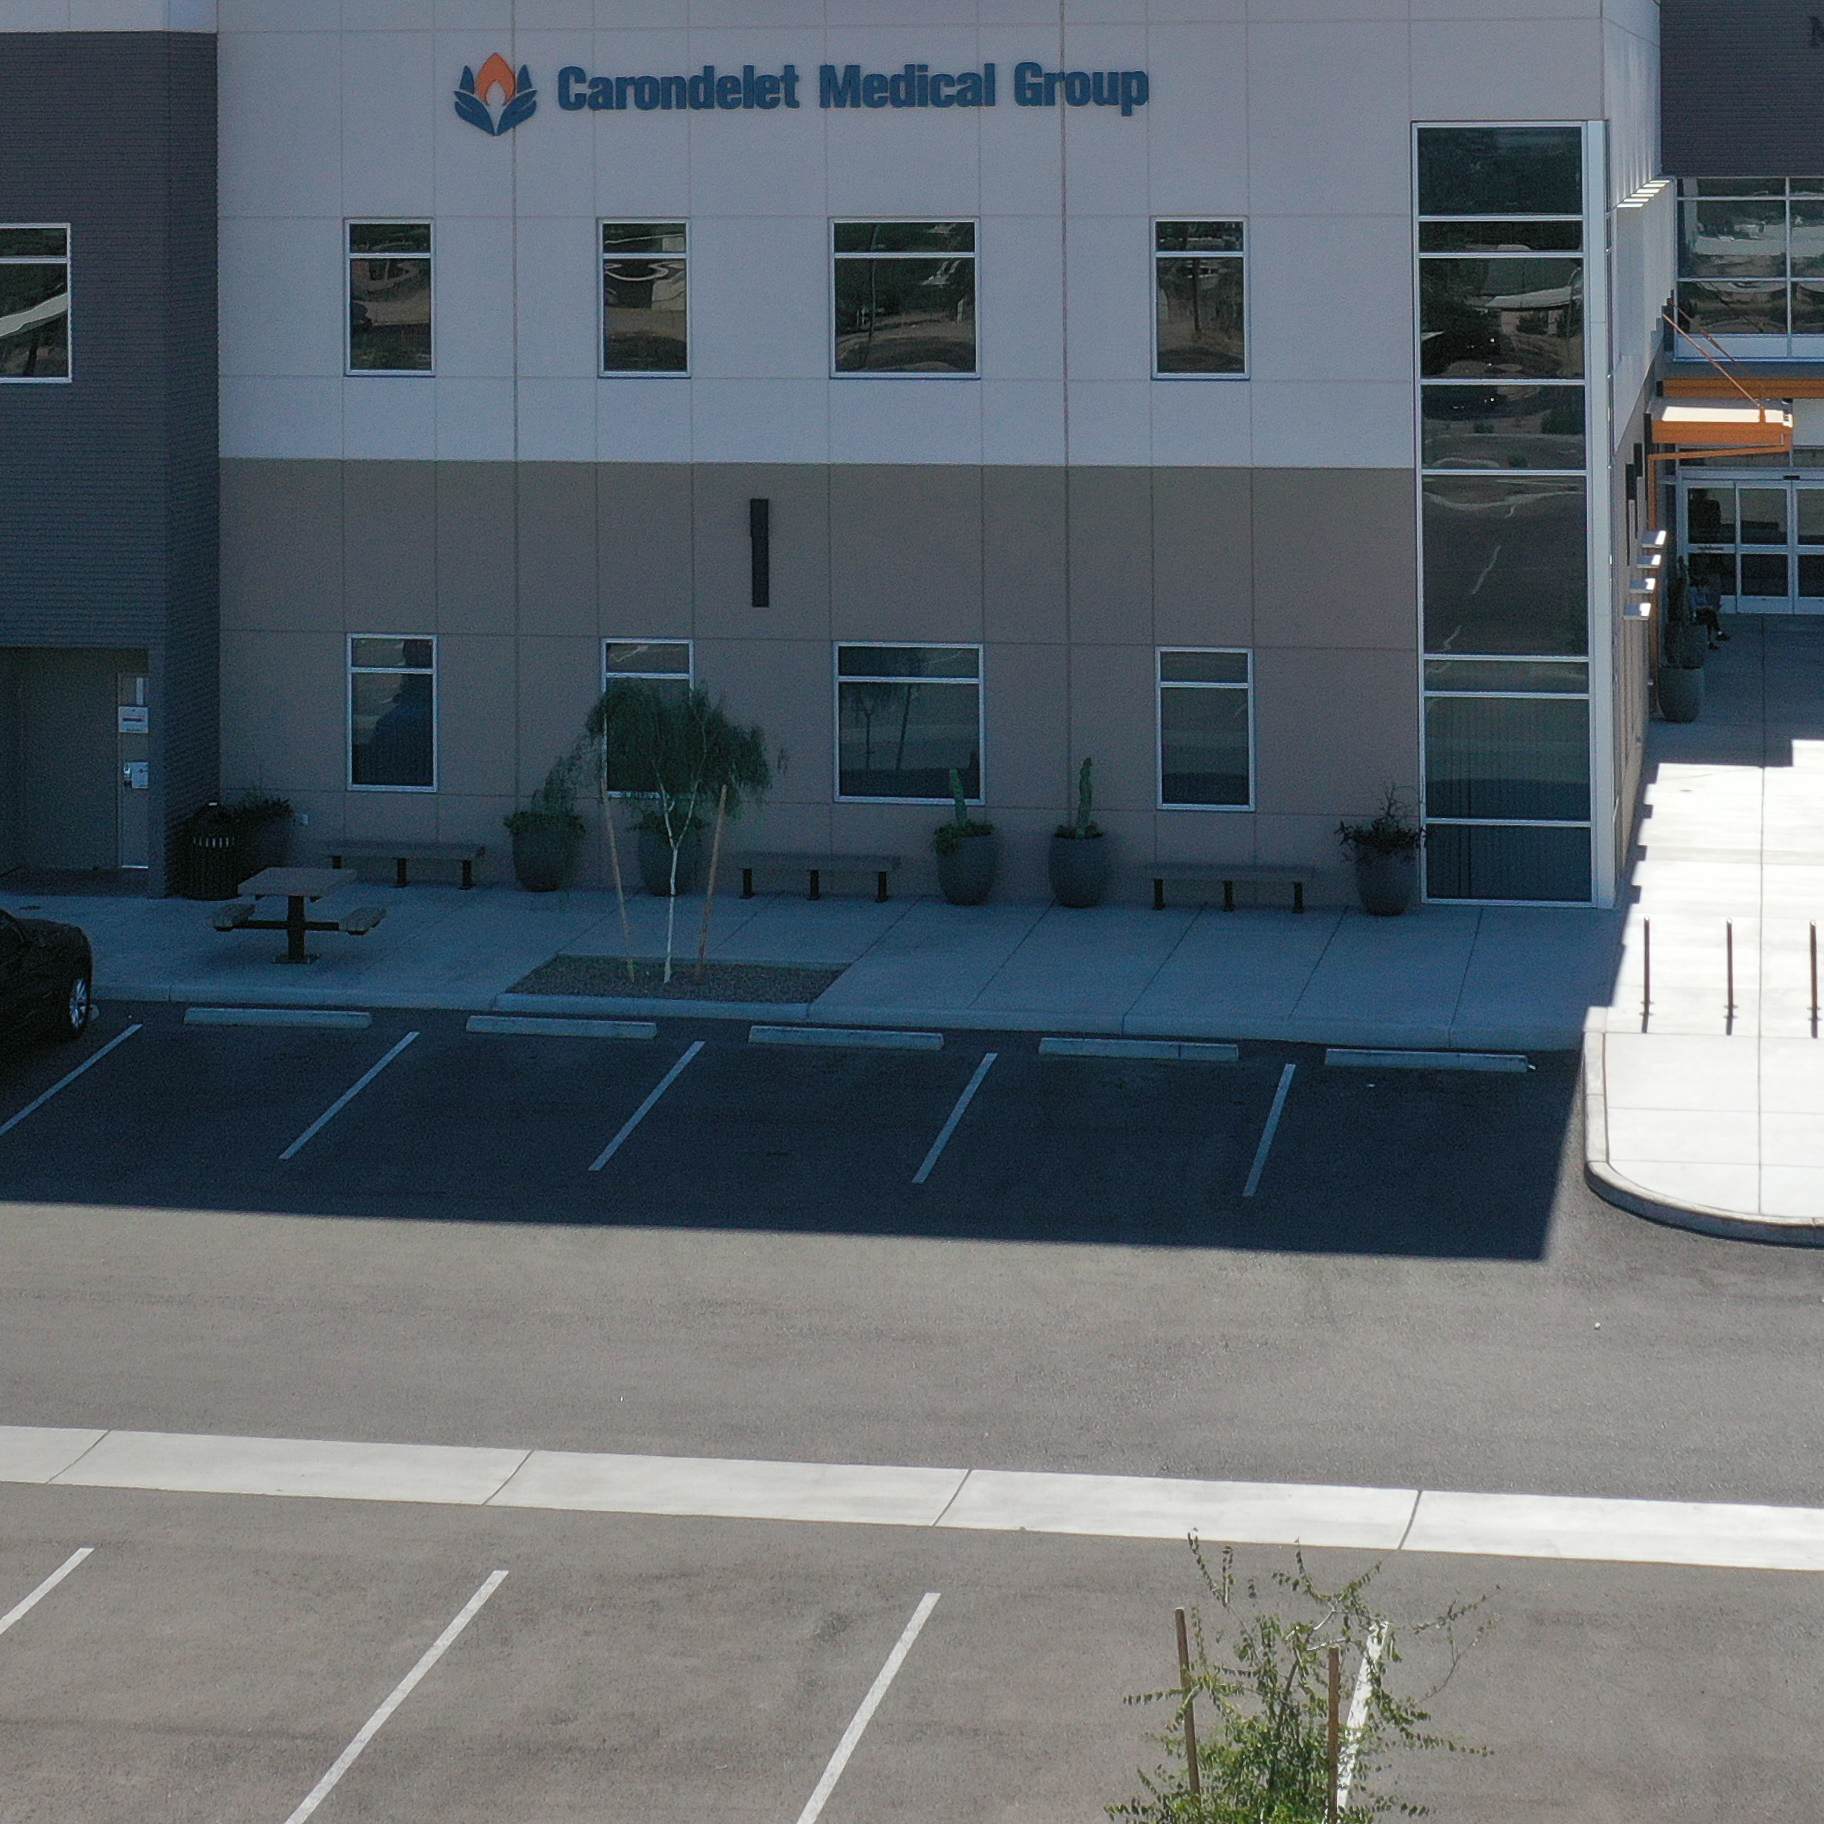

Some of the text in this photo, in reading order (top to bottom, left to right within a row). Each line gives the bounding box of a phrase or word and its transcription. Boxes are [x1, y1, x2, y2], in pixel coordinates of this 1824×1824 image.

[557, 61, 1150, 117] Carondelet Medical Group
